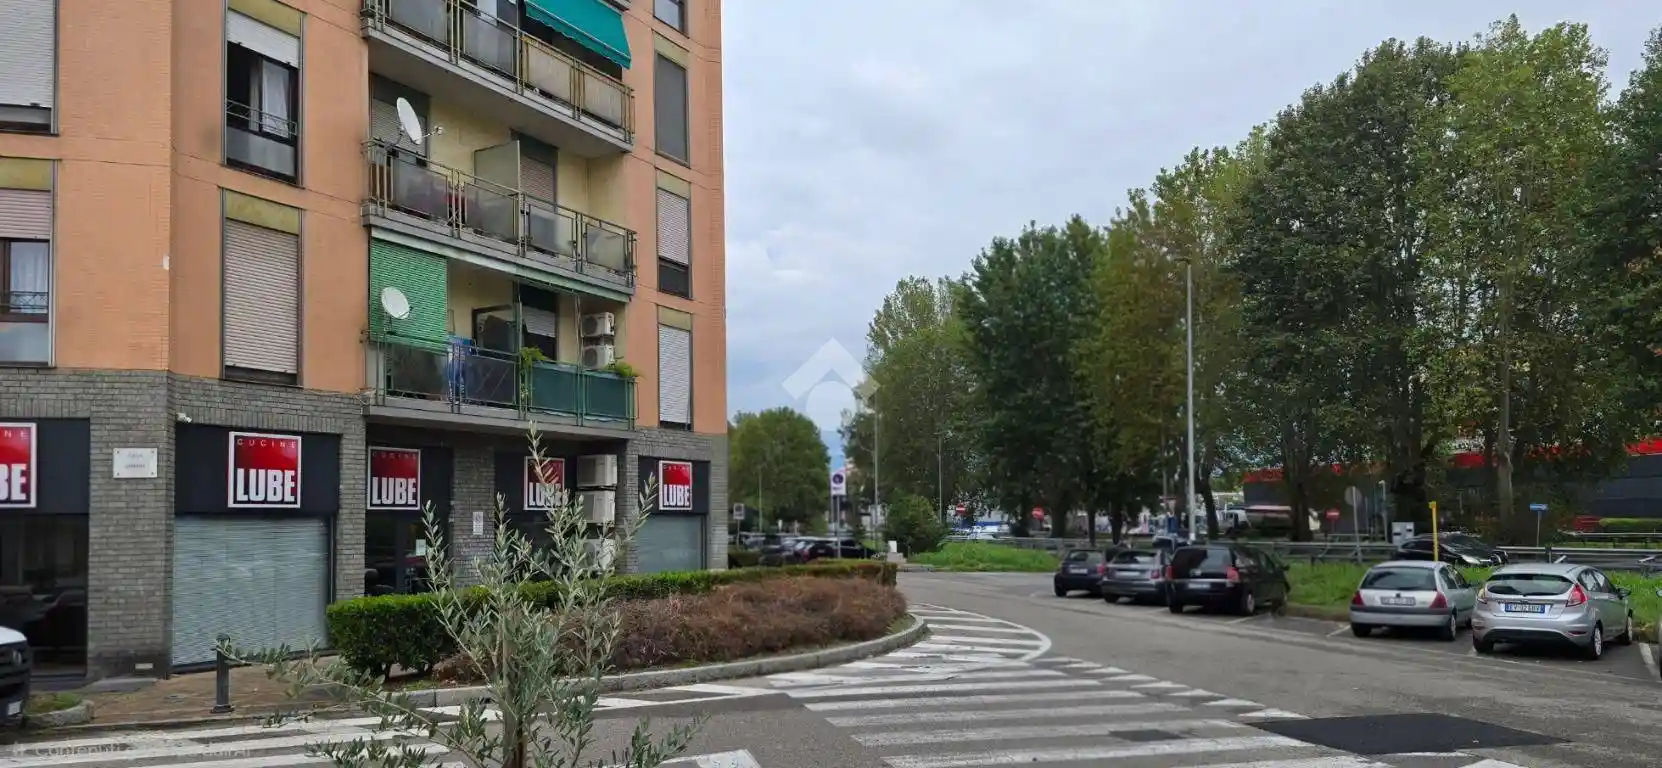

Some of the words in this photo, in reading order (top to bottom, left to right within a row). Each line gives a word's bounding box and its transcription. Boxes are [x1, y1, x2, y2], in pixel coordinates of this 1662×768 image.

[237, 438, 296, 449] CUCINE
[236, 467, 296, 502] LUBE
[371, 476, 417, 505] LUBE
[663, 483, 691, 506] LUBE
